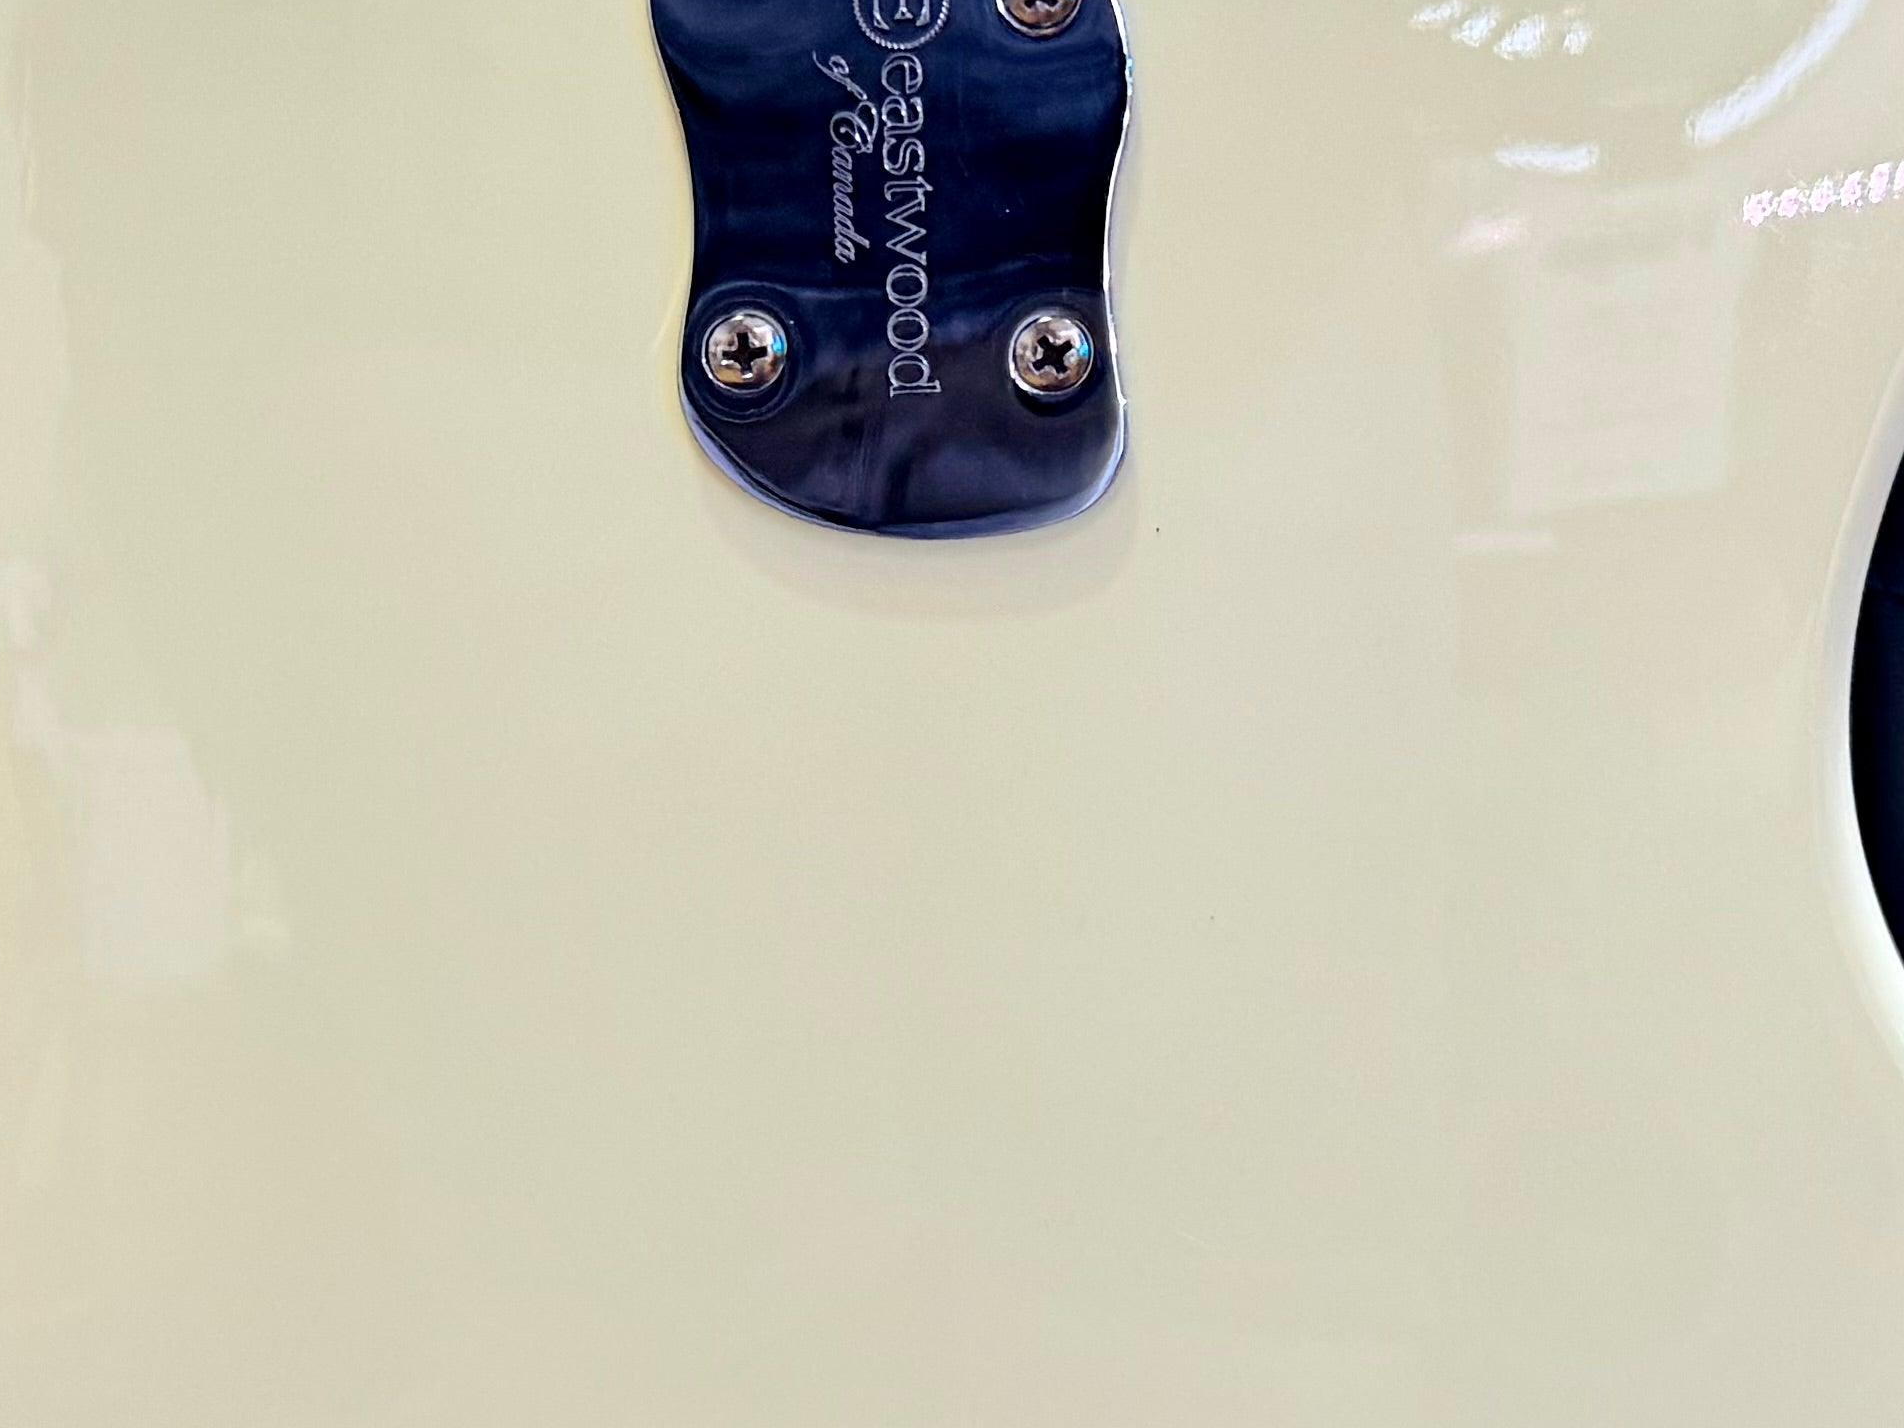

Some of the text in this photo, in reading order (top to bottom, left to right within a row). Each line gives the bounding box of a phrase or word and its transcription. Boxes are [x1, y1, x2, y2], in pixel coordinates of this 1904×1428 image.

[813, 50, 879, 263] of Canada
[881, 53, 942, 396] eastwood
